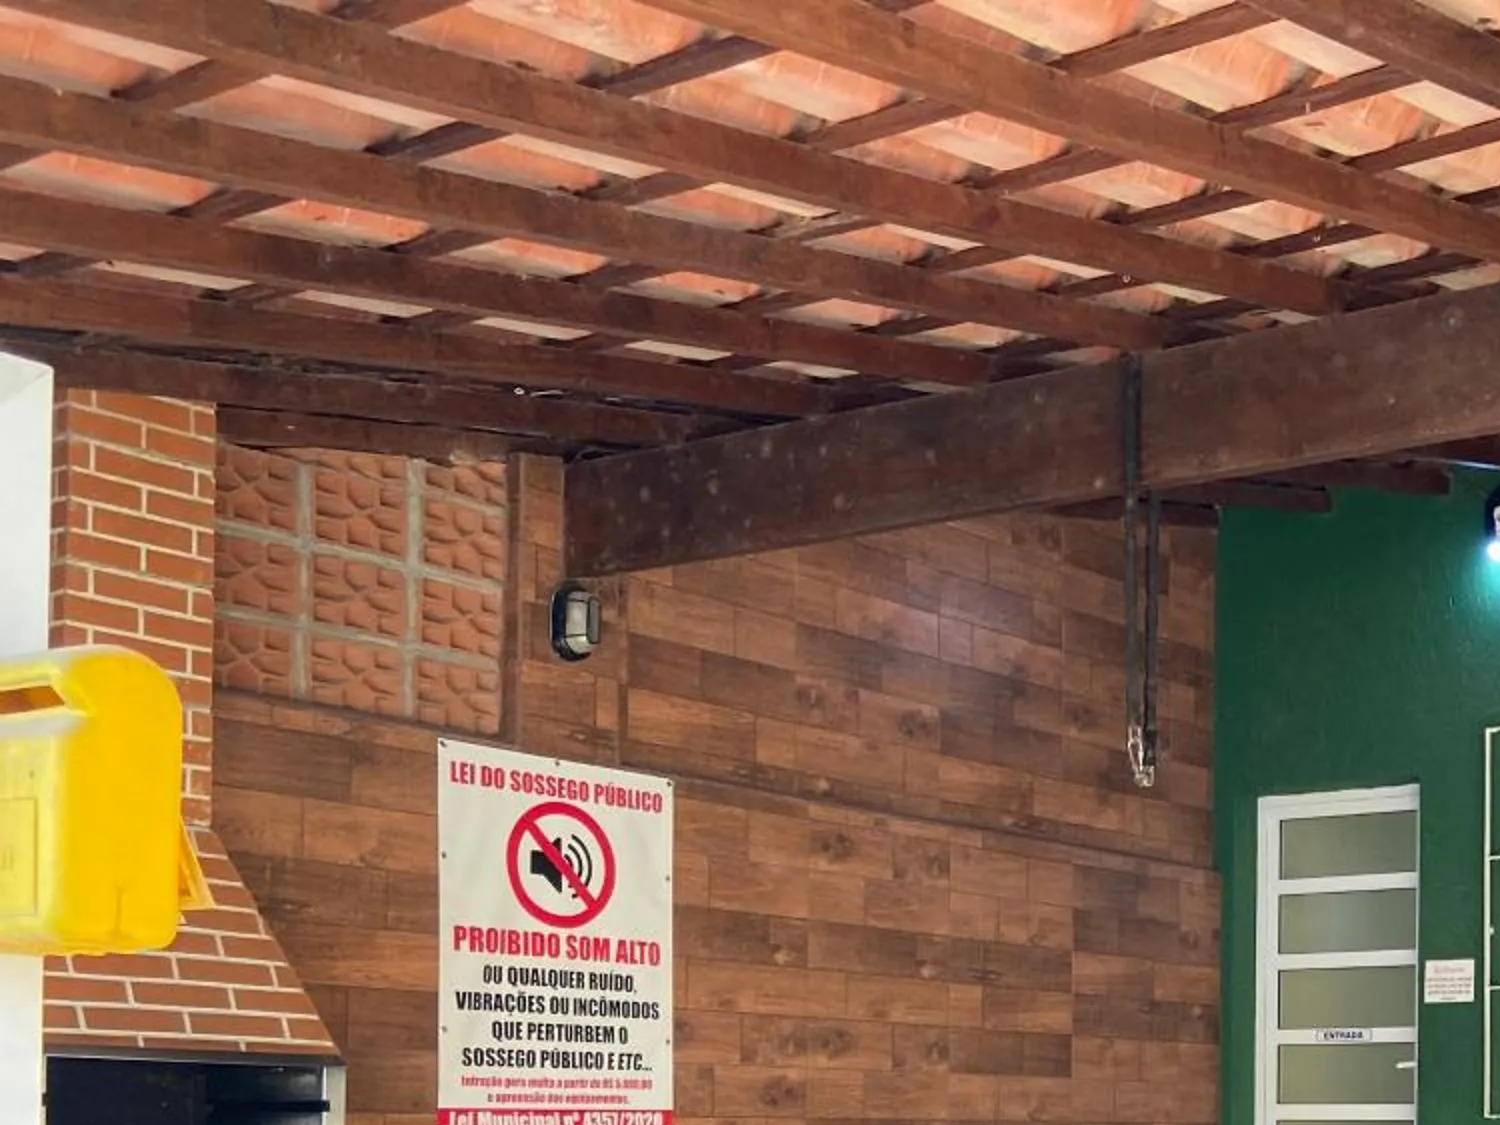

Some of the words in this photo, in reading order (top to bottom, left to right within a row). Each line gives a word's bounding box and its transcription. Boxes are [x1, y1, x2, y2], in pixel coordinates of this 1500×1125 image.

[450, 761, 475, 785] LEI
[480, 765, 505, 789] DO
[509, 769, 590, 801] SOSSEGO
[594, 781, 663, 813] PÚBLICO
[453, 925, 561, 958] PROIBIDO
[566, 935, 610, 963] SOM
[616, 939, 661, 967] ALTO
[483, 965, 503, 985] OU
[507, 967, 585, 989] QUALQUER
[455, 991, 545, 1016] VIBRAÇÕES
[550, 996, 569, 1015] OU
[573, 996, 660, 1020] INCÔMODOS
[491, 1021, 523, 1041] QUE
[527, 1022, 615, 1044] PERTURBEM
[619, 1026, 629, 1045] O
[462, 1047, 536, 1068] SOSSEGO
[540, 1048, 604, 1069] PÚBLICO
[607, 1052, 615, 1070] E
[618, 1053, 653, 1071] ETC...
